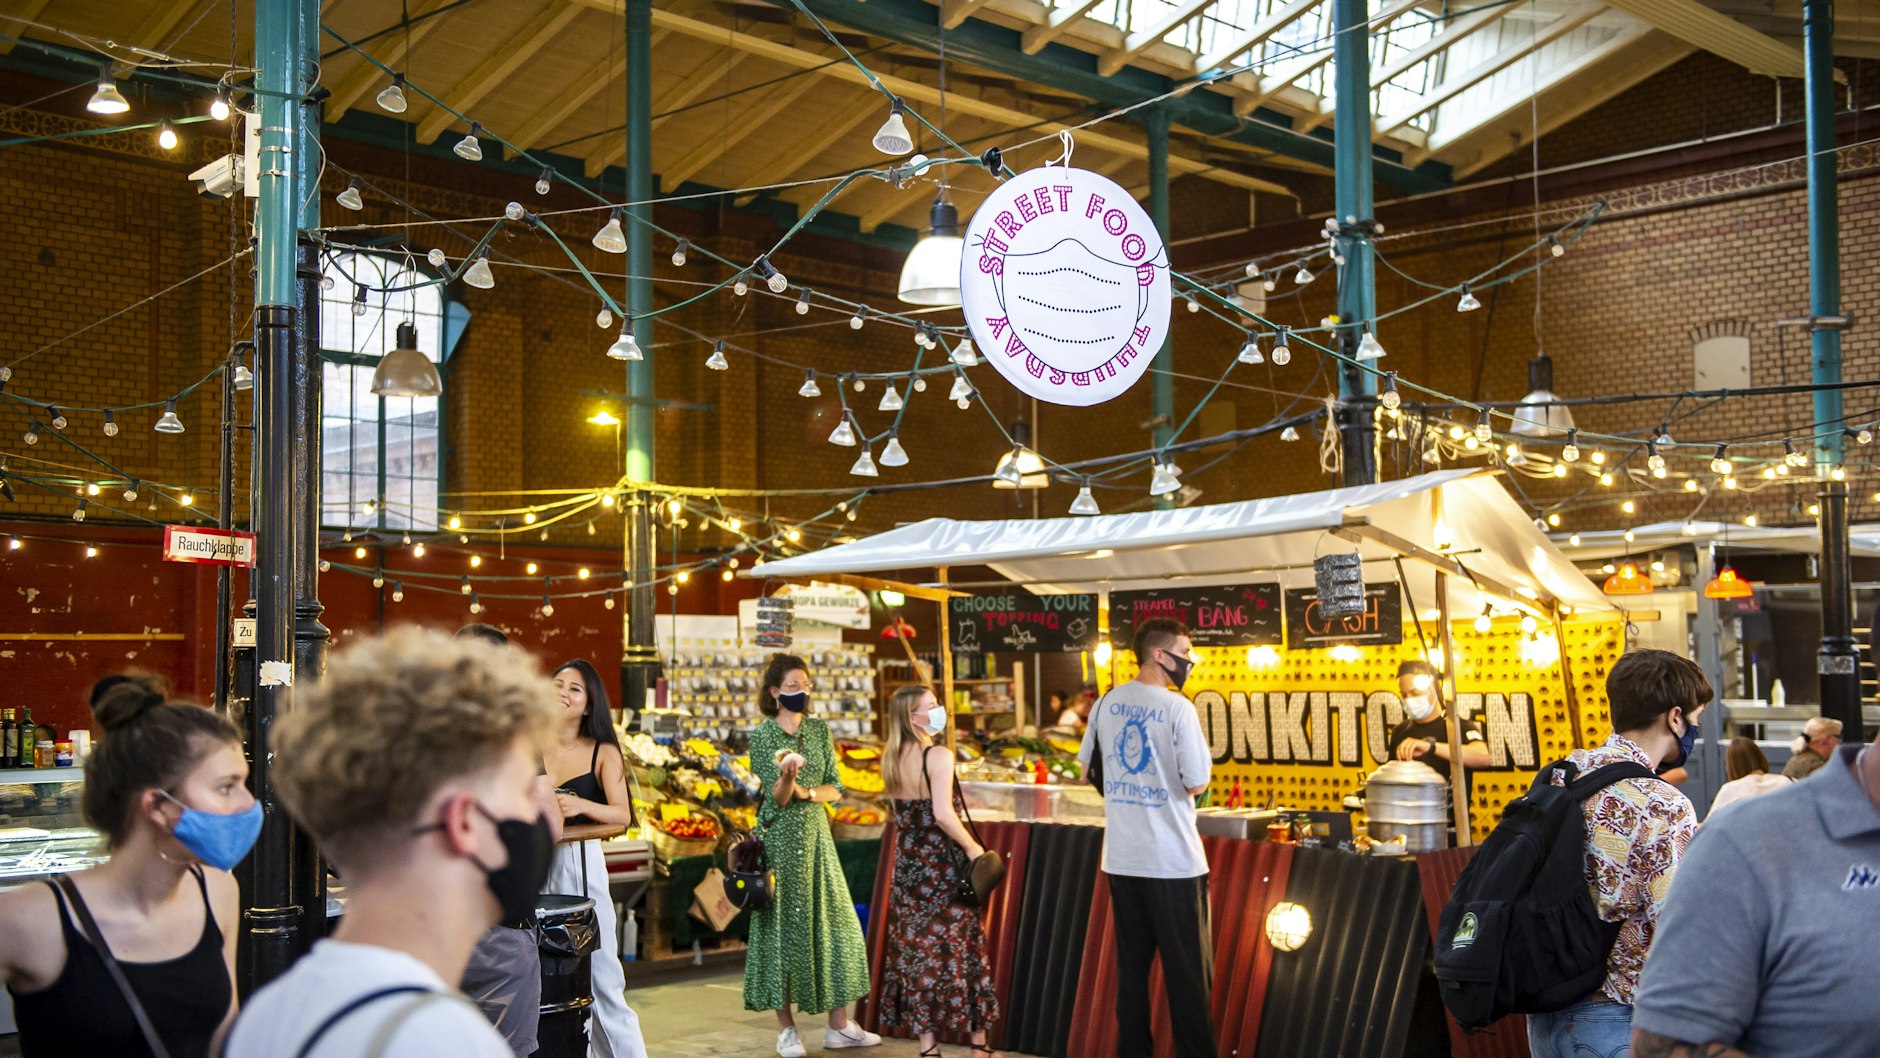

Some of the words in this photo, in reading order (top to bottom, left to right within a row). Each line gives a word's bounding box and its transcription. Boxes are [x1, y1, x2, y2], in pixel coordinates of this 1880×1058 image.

[979, 185, 1073, 276] STREET
[1086, 193, 1155, 287] FOOD
[178, 536, 244, 557] Rauchklappe
[792, 595, 816, 607] ROPA
[953, 596, 1016, 612] CHOOSE
[1040, 594, 1090, 611] YOUR
[1133, 599, 1176, 610] STEAMED
[982, 612, 1060, 631] TOPPING
[1198, 605, 1249, 628] BANG
[239, 626, 252, 637] Zu
